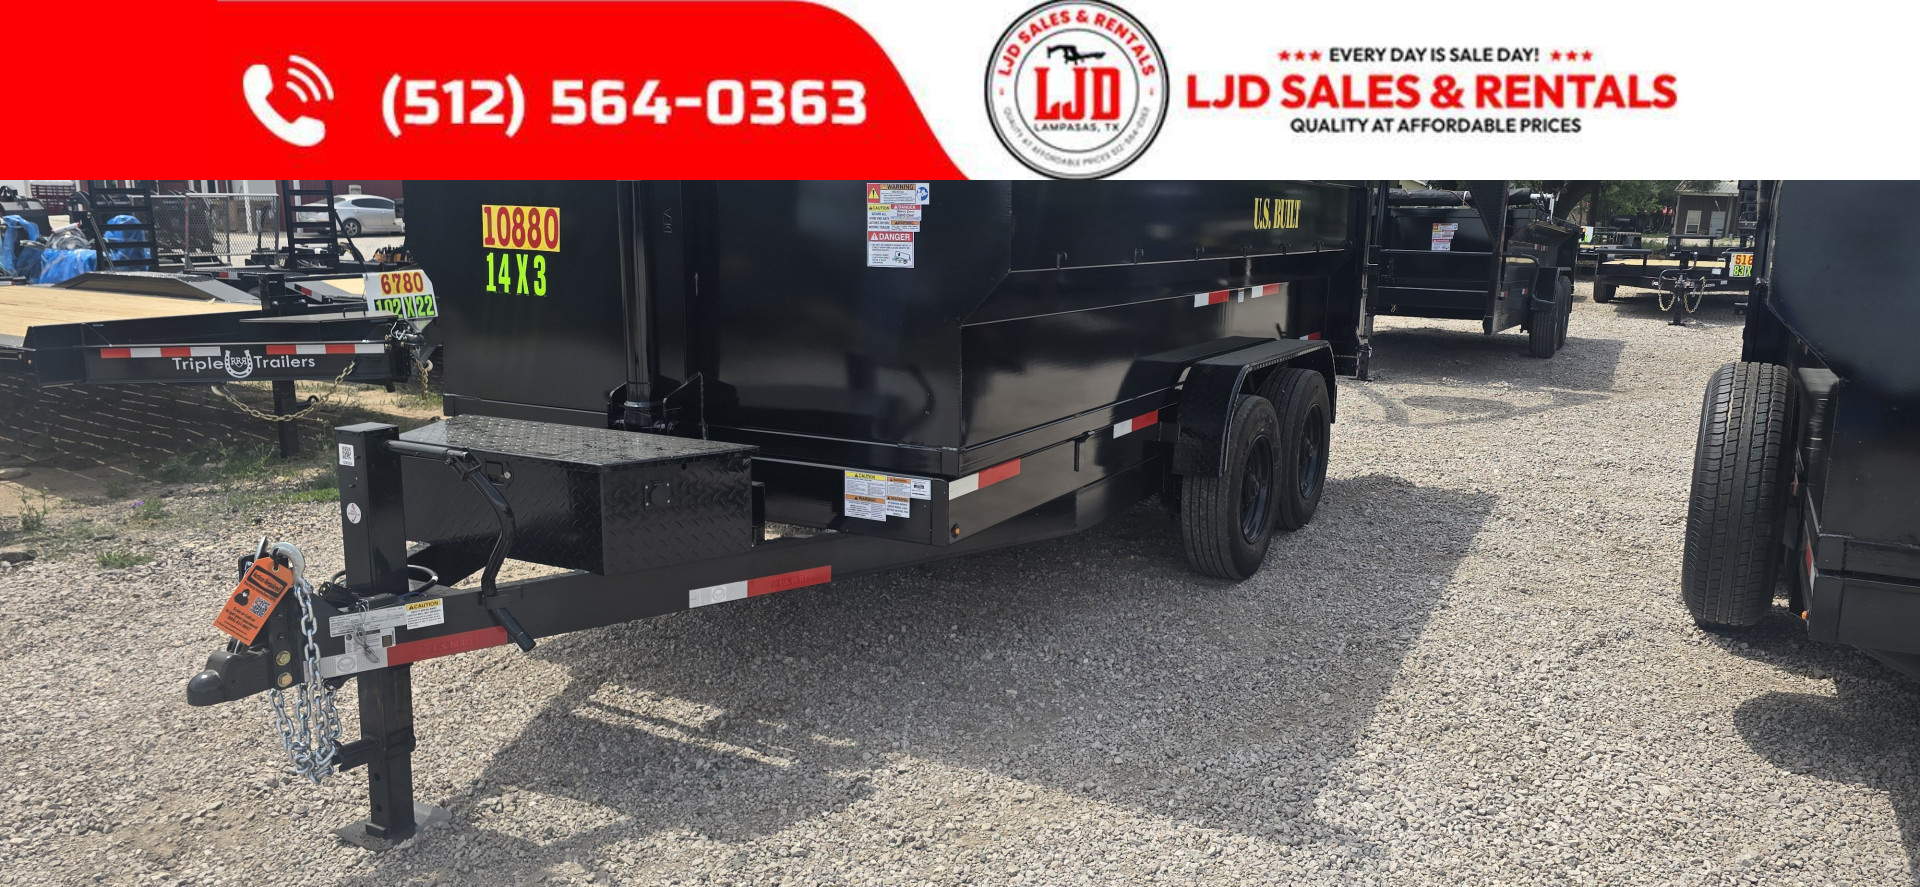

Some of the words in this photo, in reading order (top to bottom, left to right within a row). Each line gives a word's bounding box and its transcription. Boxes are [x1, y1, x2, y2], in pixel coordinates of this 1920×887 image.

[1254, 198, 1271, 229] U.S.
[1273, 199, 1301, 229] BUILT
[484, 206, 559, 249] 10880
[879, 233, 911, 241] DANGER
[486, 252, 511, 293] 14
[516, 253, 530, 295] X
[533, 254, 547, 296] 3
[1734, 265, 1745, 276] 83
[1746, 265, 1753, 276] X
[381, 272, 424, 295] 6780
[403, 296, 416, 318] X
[415, 295, 435, 317] 22
[171, 357, 224, 373] Triple
[253, 355, 316, 369] Trailers
[414, 601, 439, 609] CAUTION
